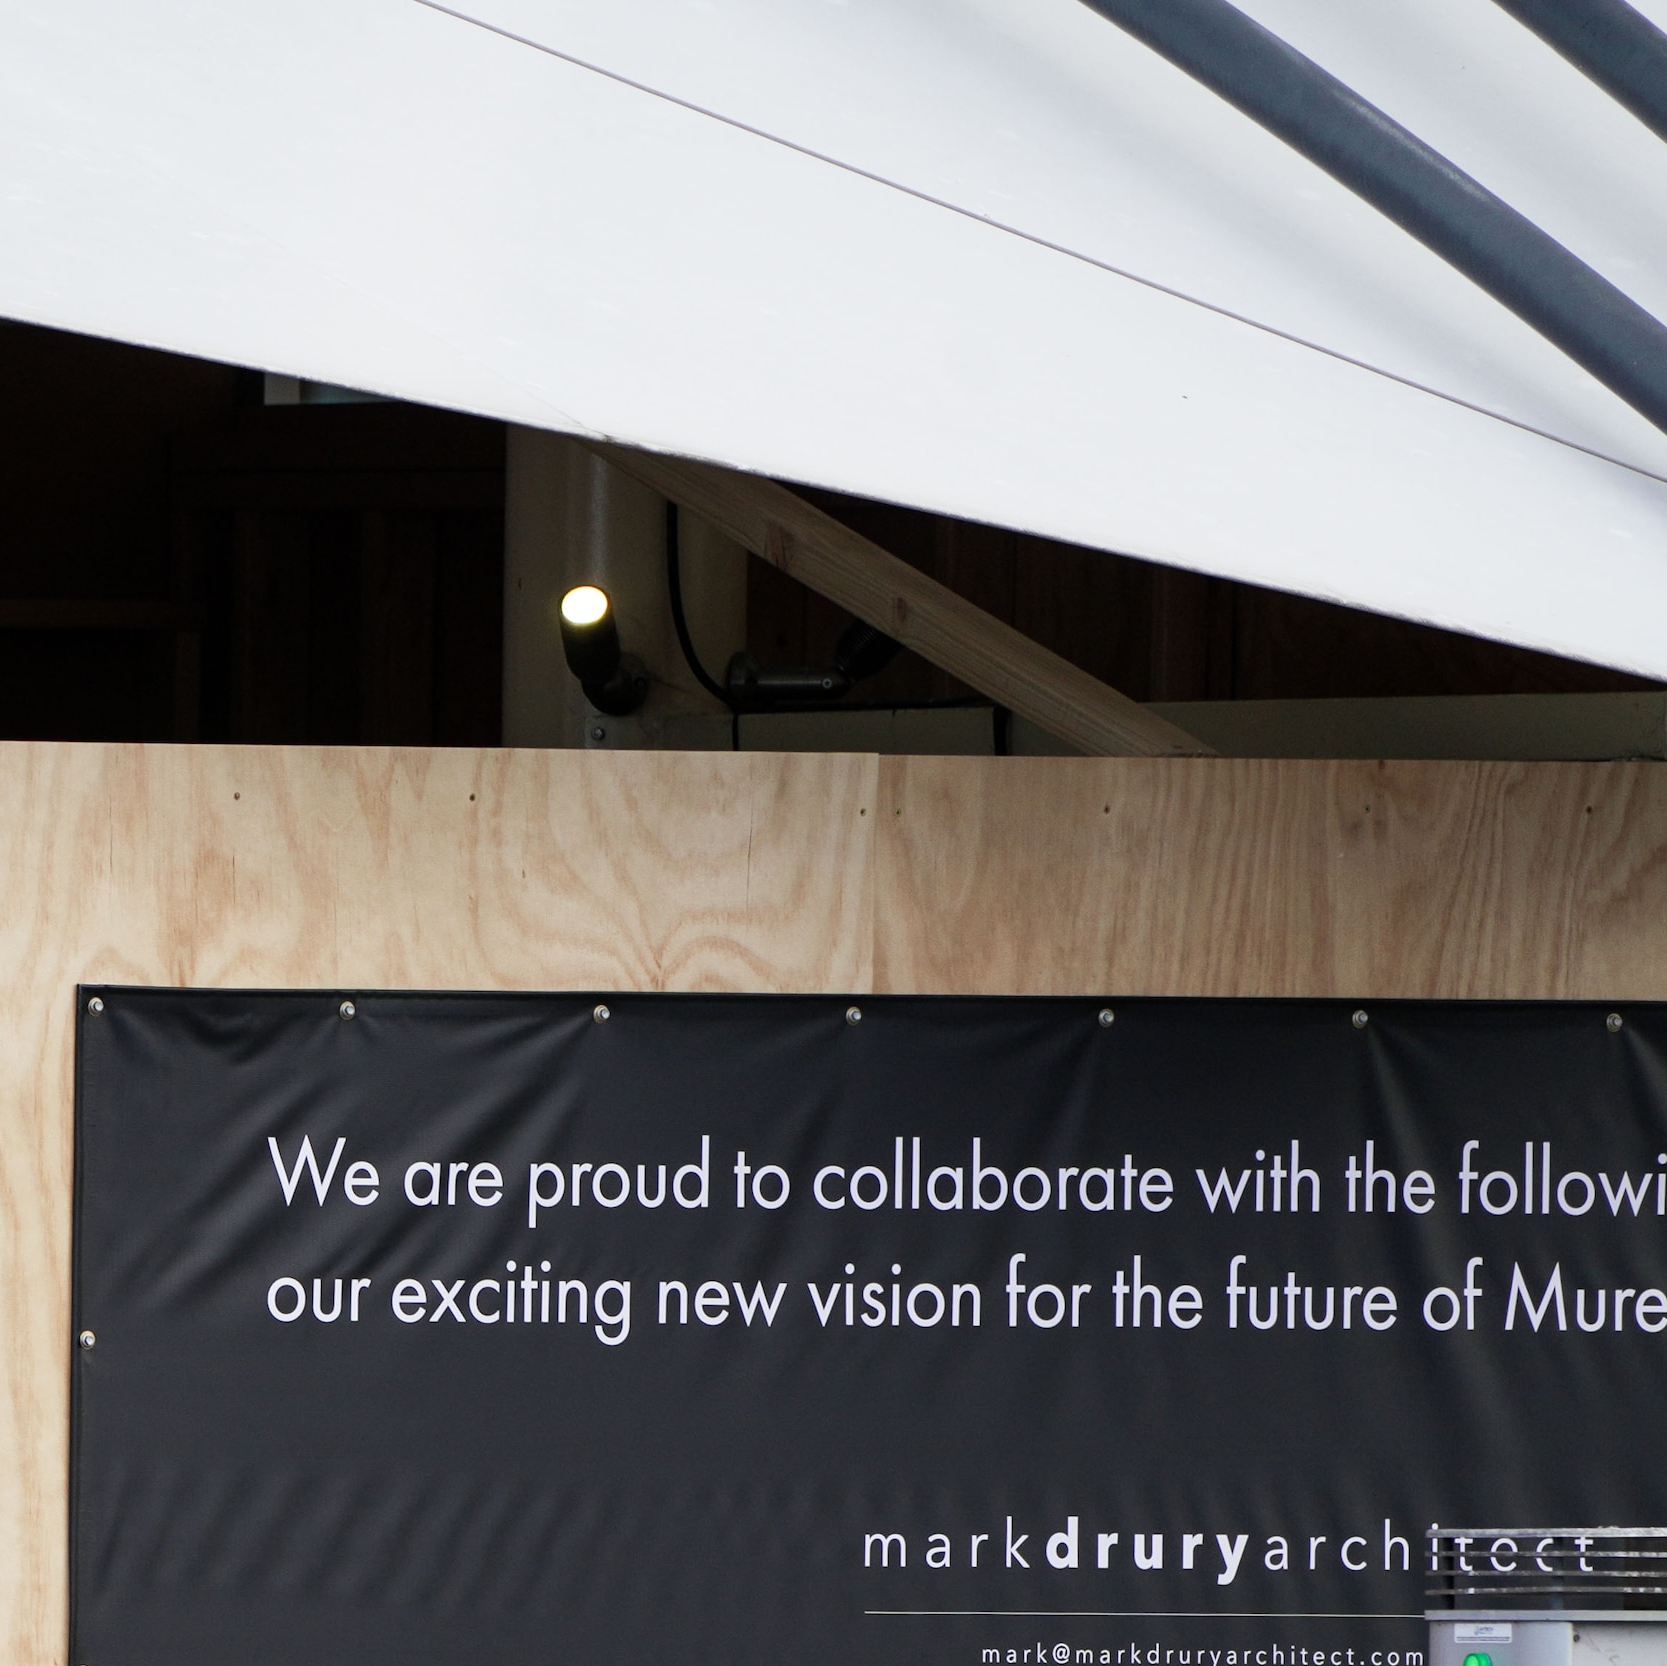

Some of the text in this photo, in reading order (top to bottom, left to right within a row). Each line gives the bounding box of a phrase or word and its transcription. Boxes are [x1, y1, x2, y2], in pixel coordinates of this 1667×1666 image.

[267, 1134, 1667, 1229] We are proud to collaborate with the followi
[267, 1252, 1667, 1346] our exciting new vision for the future of Mure
